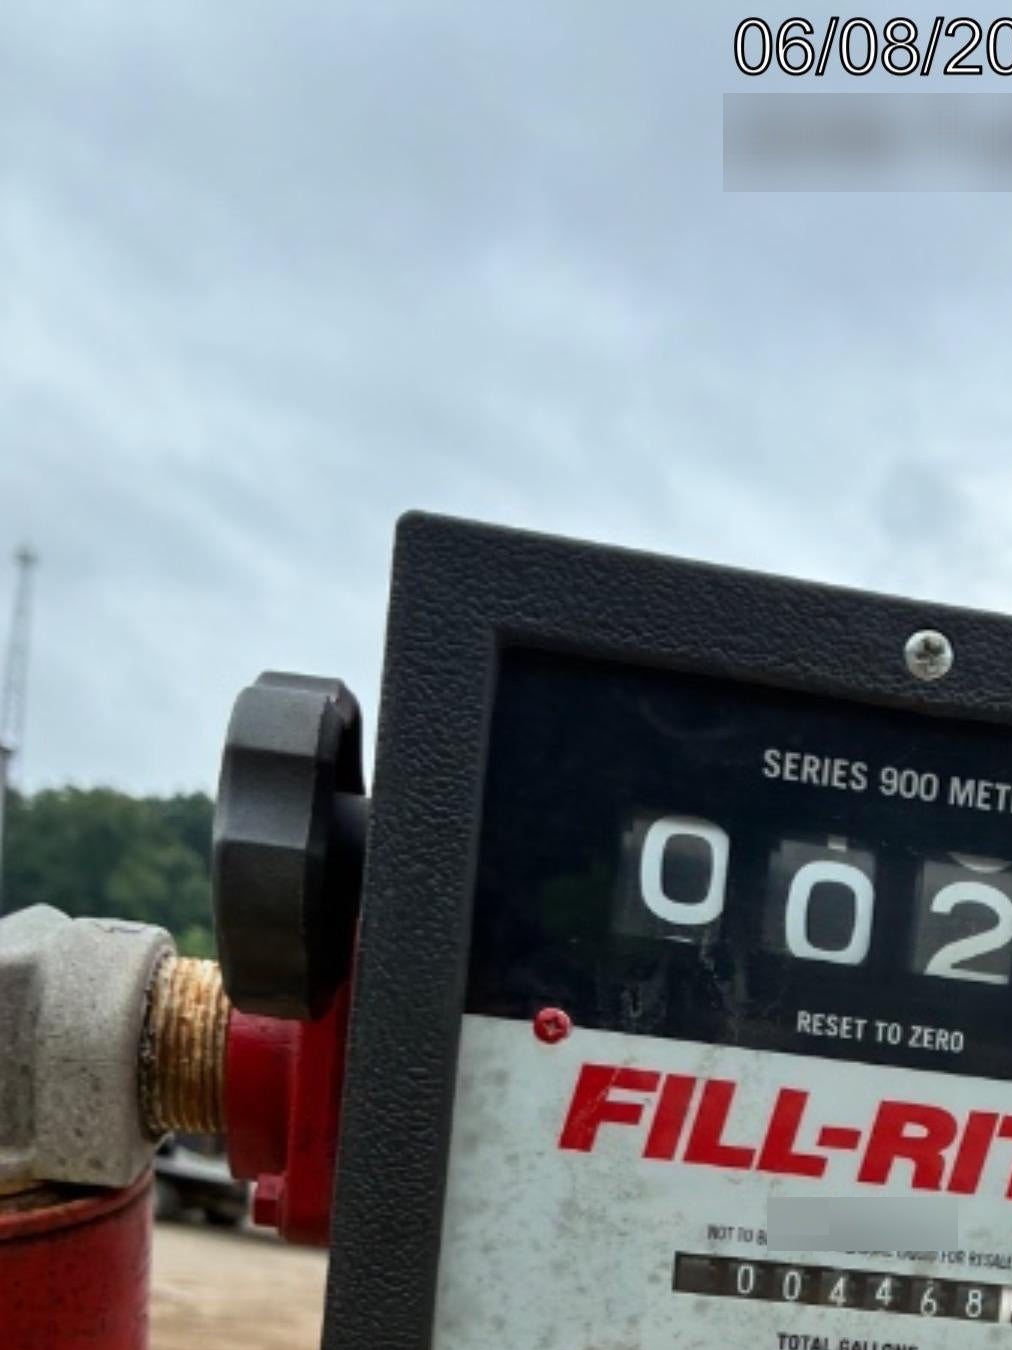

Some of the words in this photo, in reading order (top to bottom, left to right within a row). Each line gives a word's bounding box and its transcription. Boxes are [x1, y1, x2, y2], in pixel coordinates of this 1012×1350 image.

[763, 749, 868, 792] SERIES
[880, 767, 938, 801] 900
[797, 1010, 866, 1040] RESET
[875, 1023, 901, 1046] TO
[909, 1025, 964, 1053] ZERO
[707, 1224, 734, 1241] NOT
